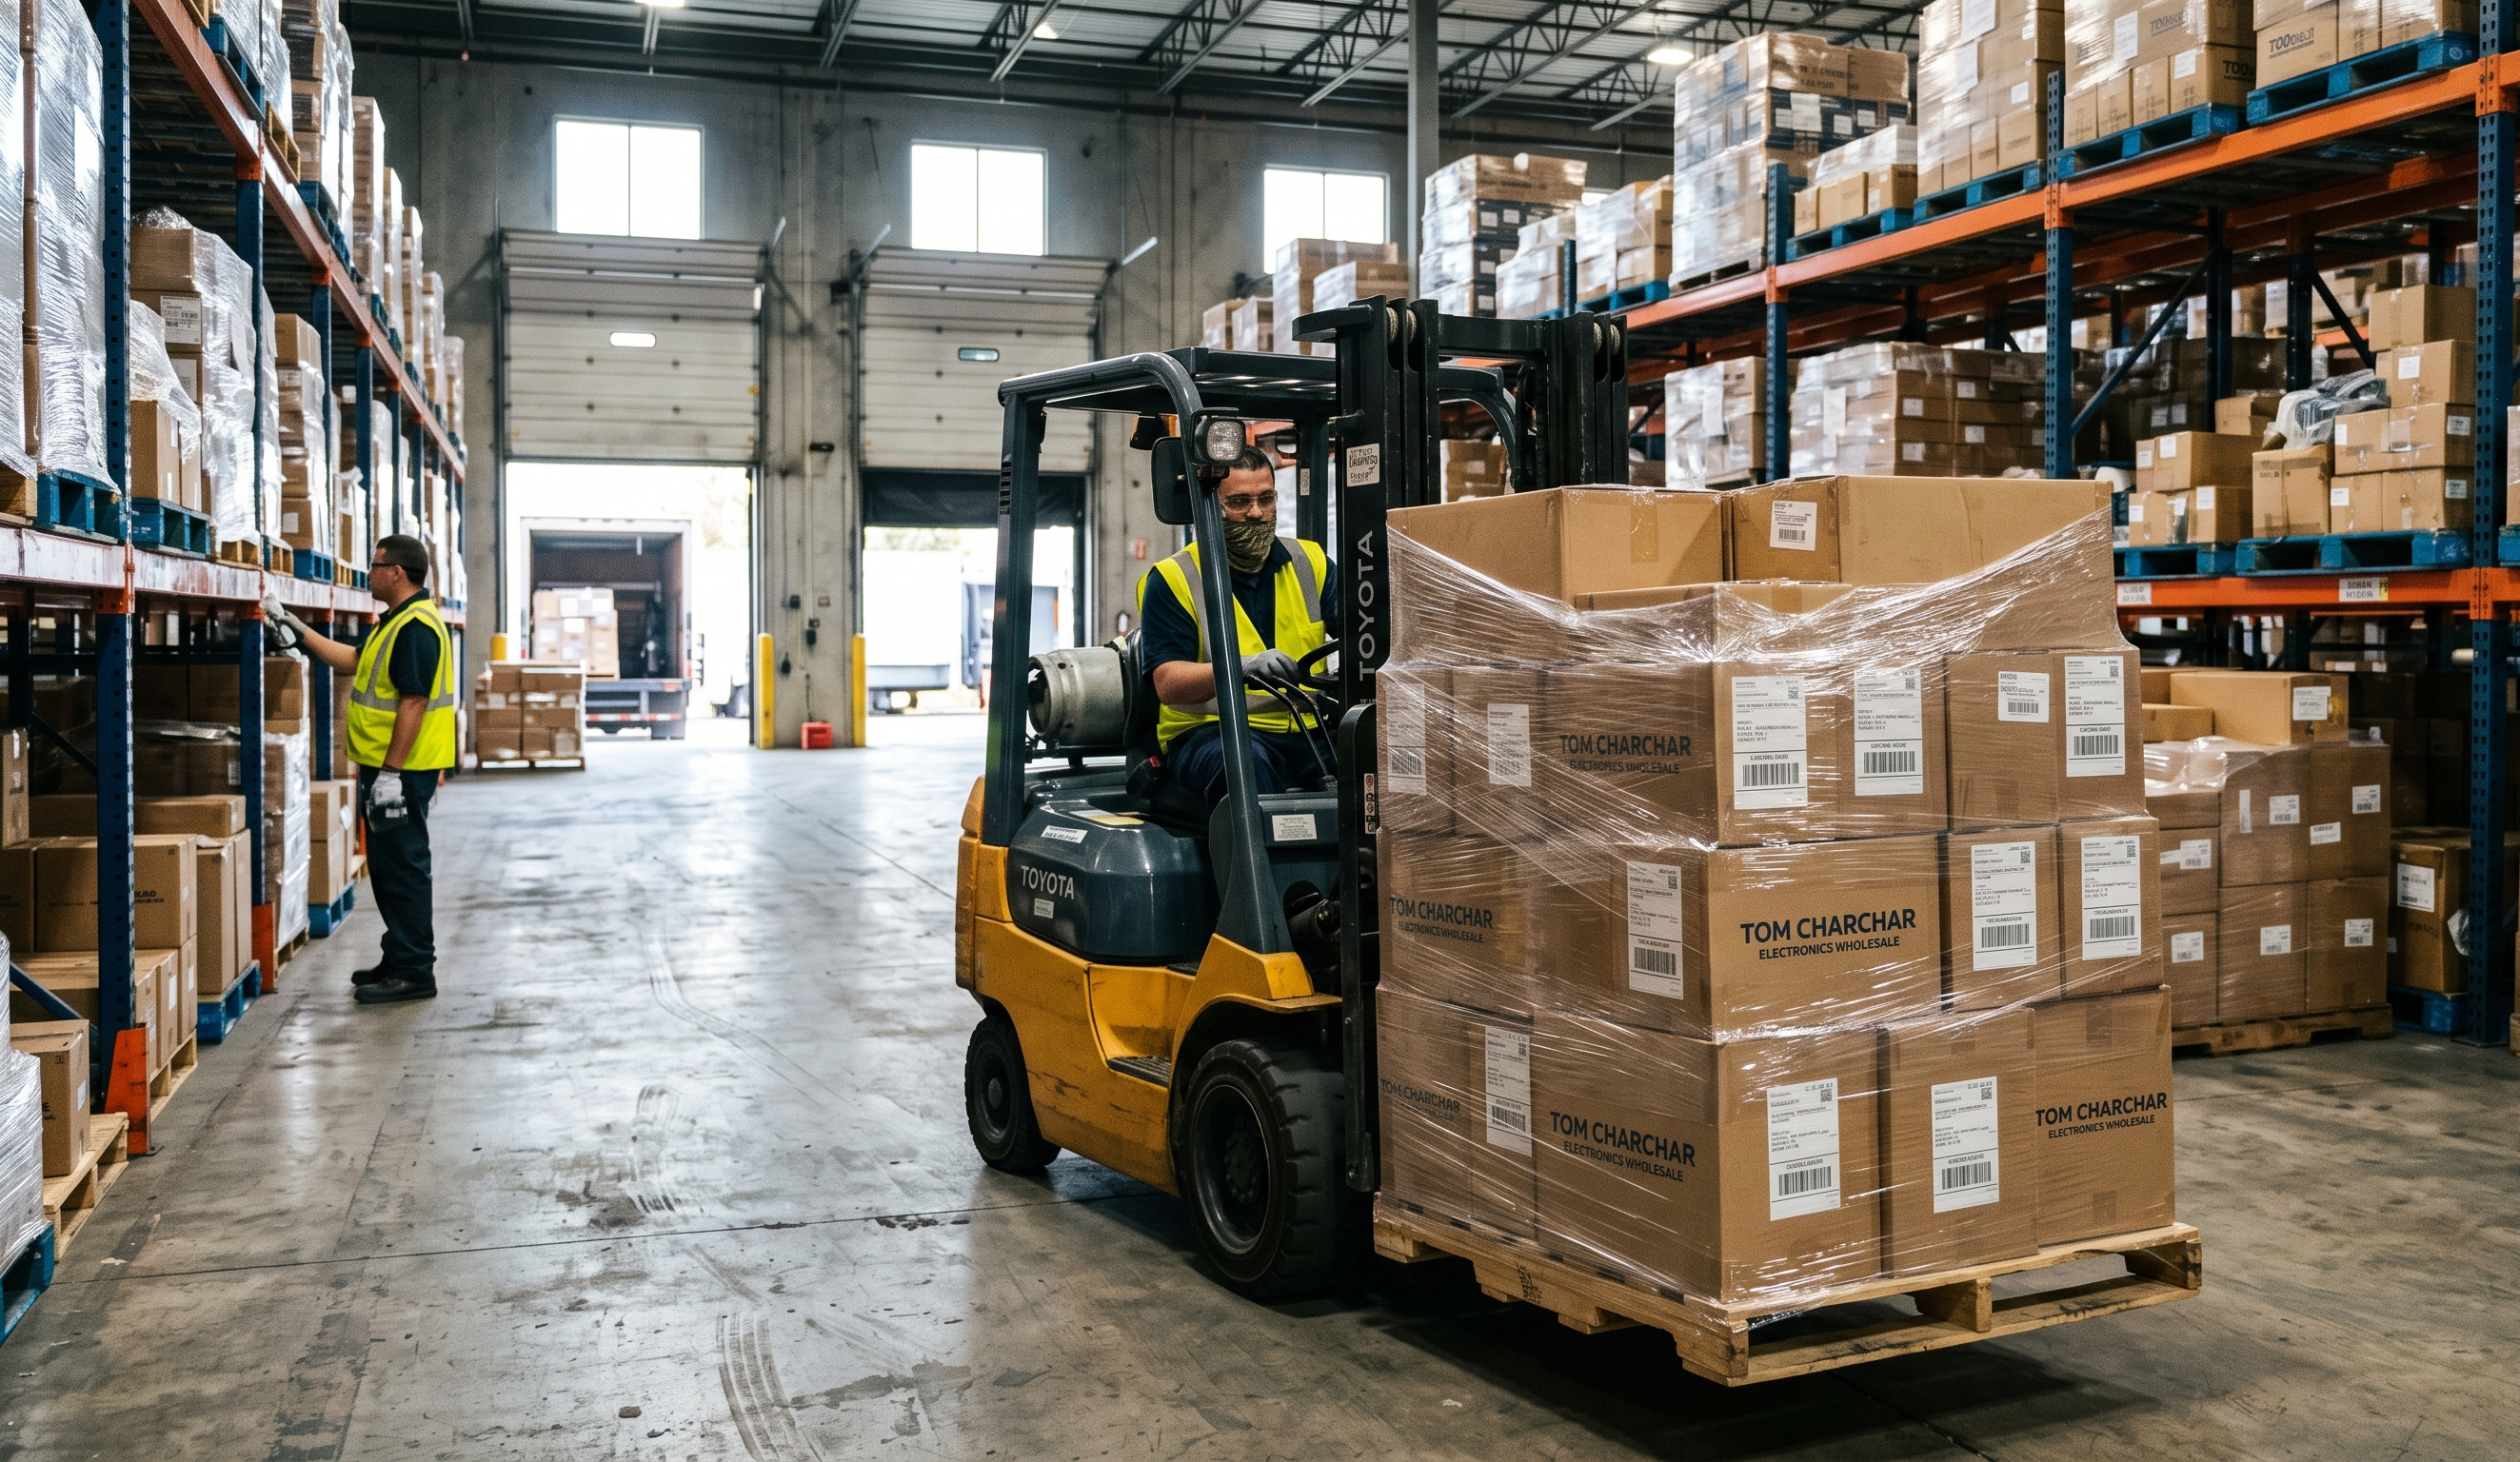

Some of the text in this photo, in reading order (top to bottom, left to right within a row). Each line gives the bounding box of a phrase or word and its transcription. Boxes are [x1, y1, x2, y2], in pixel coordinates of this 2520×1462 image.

[1358, 530, 1376, 682] TOYOTA
[1558, 734, 1692, 757] TOM CHARCHAR
[1021, 864, 1075, 900] TOYOTA
[1389, 897, 1493, 929] TOM CHARCHAR
[1739, 908, 1917, 944] TOM CHARCHAR
[1758, 936, 1900, 960] ELECTRONICS WHOLESALE
[2035, 1092, 2168, 1127] TOM CHARCHAR
[2048, 1114, 2155, 1139] ELECTRONICS WHOLESALE
[1550, 1111, 1696, 1167] TOM CHARCHAR
[1564, 1140, 1684, 1182] ELECTRONICS WHOLESALE
